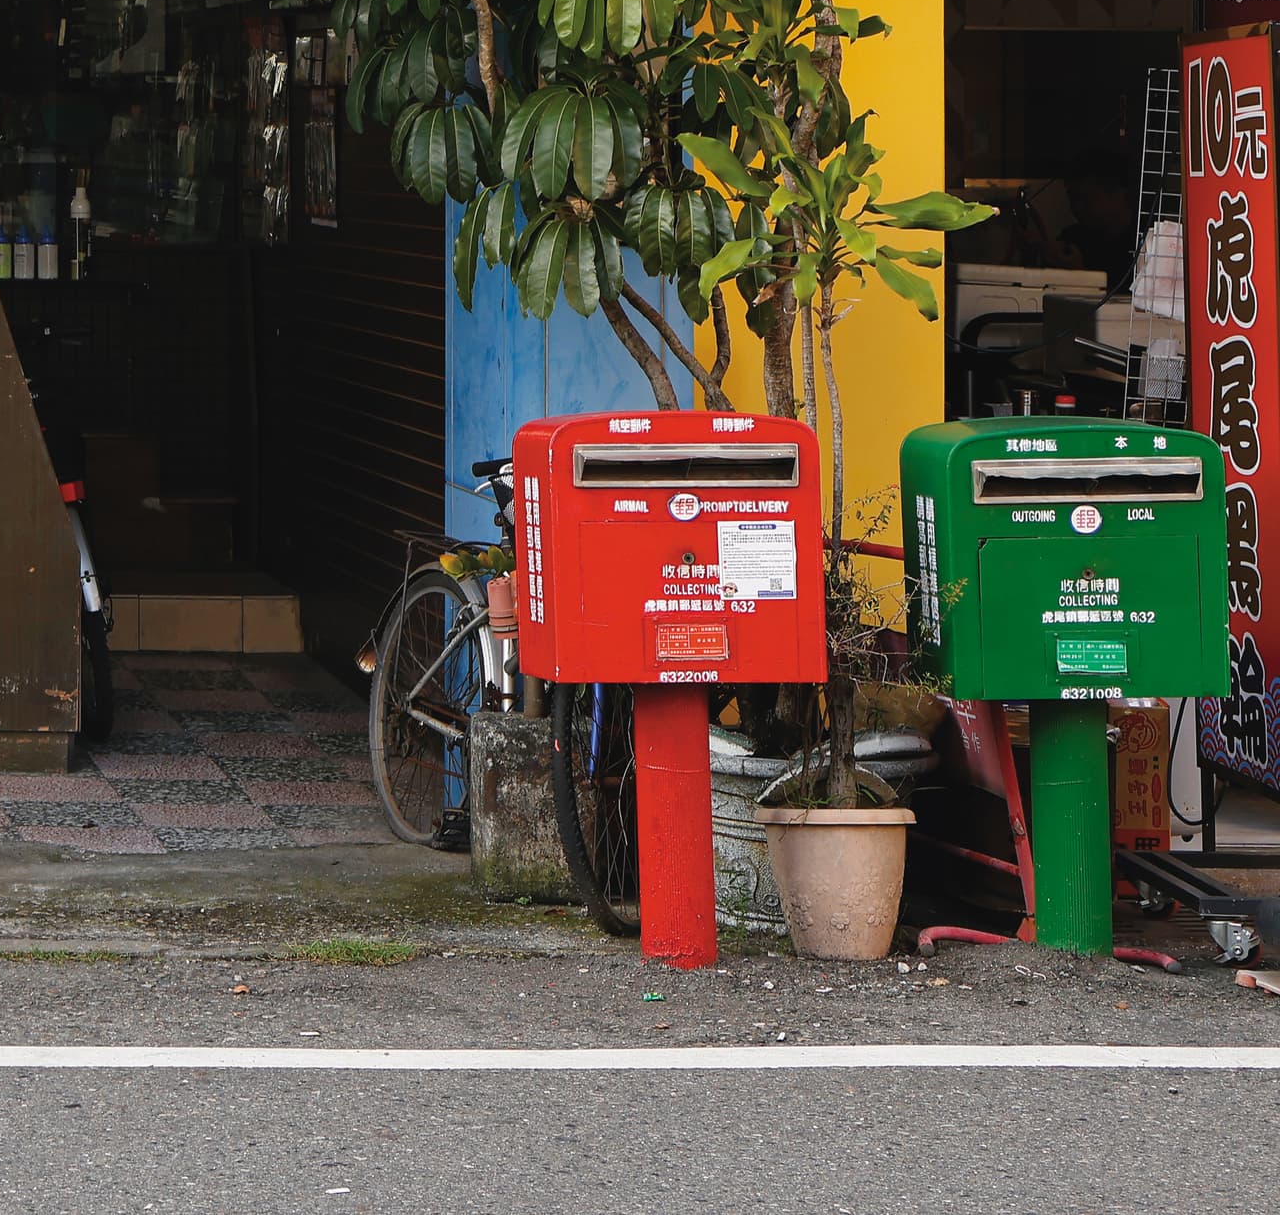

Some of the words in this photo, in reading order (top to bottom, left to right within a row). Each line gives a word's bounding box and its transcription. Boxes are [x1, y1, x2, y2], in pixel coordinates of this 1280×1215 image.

[1187, 57, 1269, 179] 10元
[609, 418, 652, 433] 航空郵件
[712, 417, 755, 433] 限時郵件
[1006, 439, 1058, 452] 其他地區
[614, 500, 649, 513] AIRMAIL
[1012, 510, 1056, 522] OUTGOING
[1127, 508, 1155, 521] LOCAL
[662, 564, 719, 579] 收信時間
[663, 583, 720, 595] COLLECTING
[1060, 578, 1120, 593] 收信時間
[730, 600, 755, 613] 632
[1059, 594, 1118, 607] COLLECTING
[1130, 611, 1155, 623] 632
[660, 671, 718, 683] 6322006
[1062, 687, 1122, 699] 6321008
